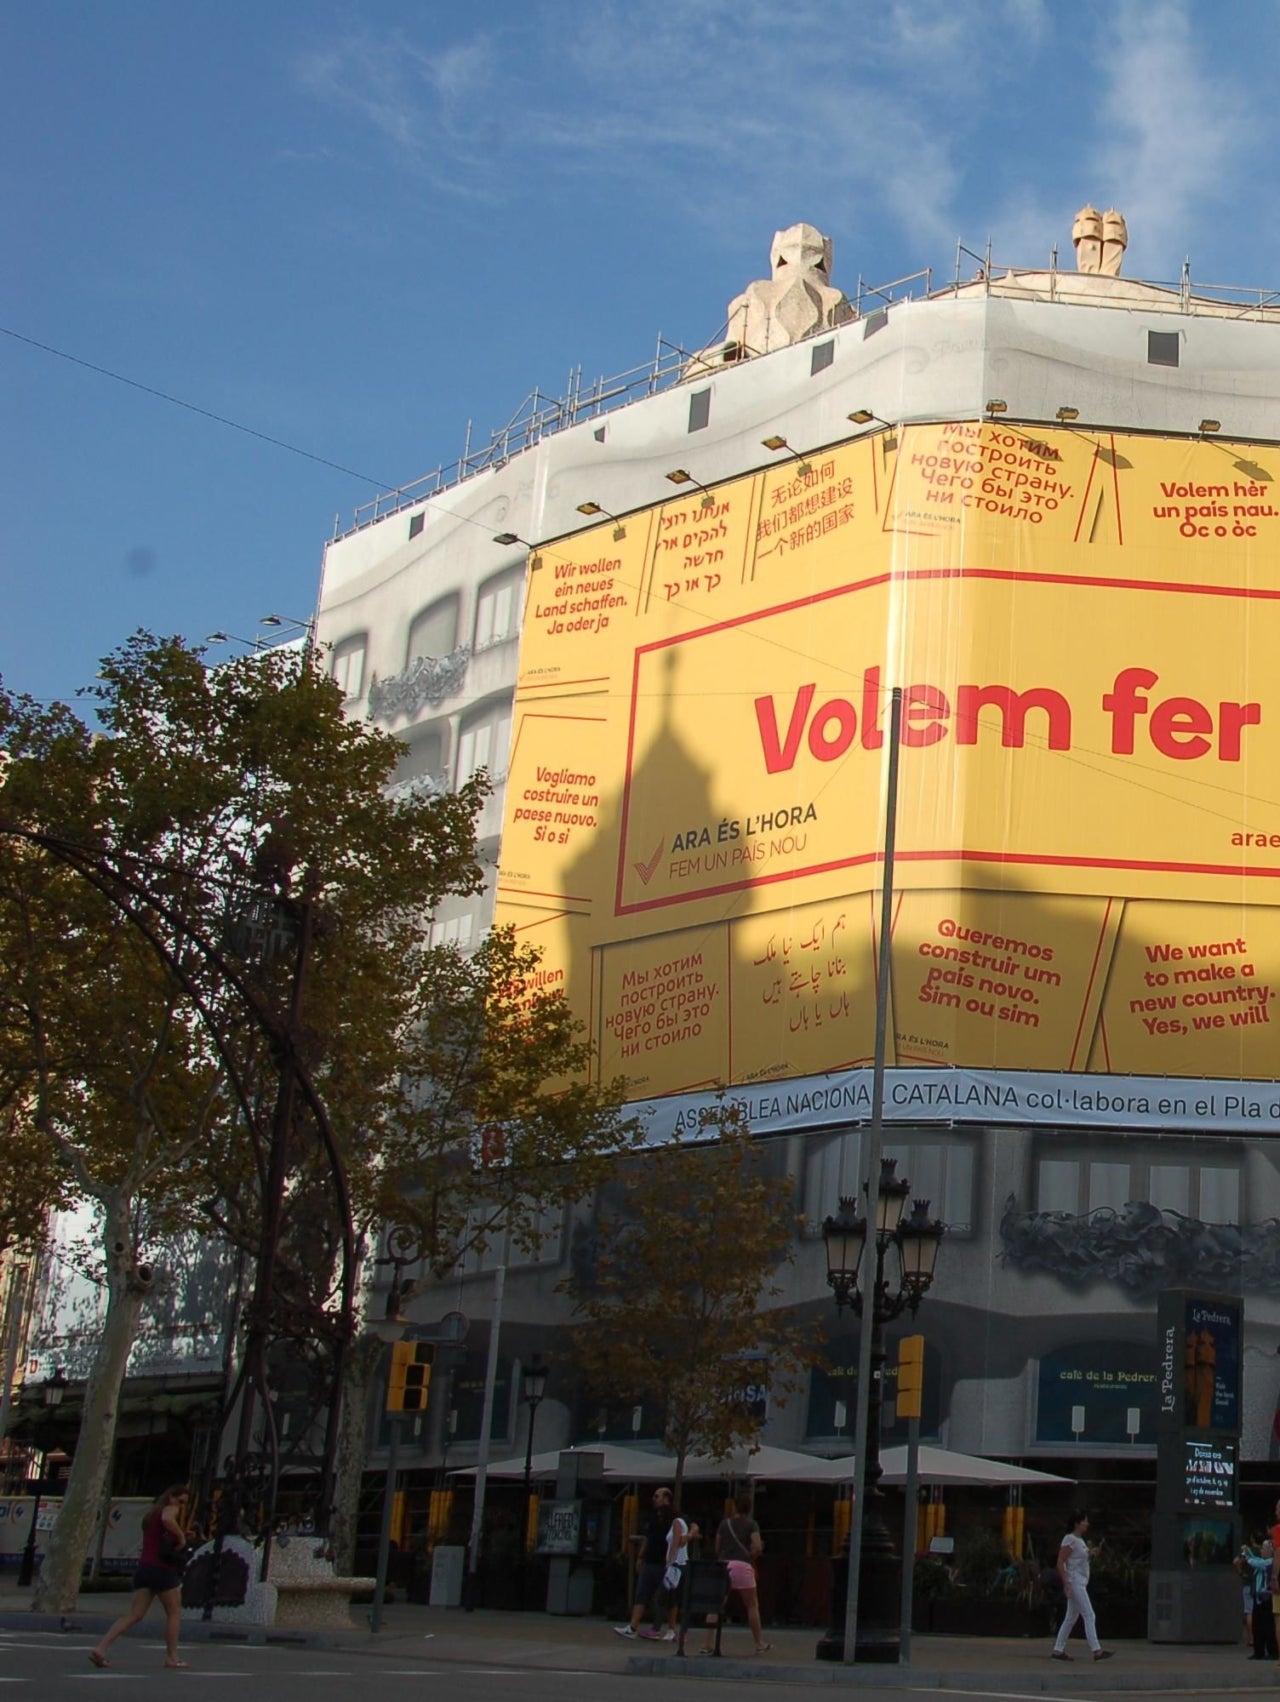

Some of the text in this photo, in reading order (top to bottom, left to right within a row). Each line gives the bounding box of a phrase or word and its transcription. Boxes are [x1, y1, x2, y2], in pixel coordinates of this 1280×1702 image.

[989, 431, 1059, 460] хотим
[911, 454, 1075, 500] новую страну.
[921, 468, 1058, 510] Чего бы это
[1160, 480, 1268, 498] Volem hèr
[926, 490, 954, 504] ни
[962, 495, 1043, 524] стоило
[1153, 500, 1279, 522] un país nau.
[758, 503, 854, 559] 一个新的国家
[1214, 526, 1227, 537] o
[1232, 520, 1257, 537] òc
[555, 558, 621, 579] Wir wollen
[684, 549, 724, 570] חדשה
[555, 578, 614, 598] ein neues
[664, 573, 721, 602] כך או כך
[535, 594, 627, 618] Land schaffen.
[547, 613, 609, 635] Ja oder ja
[755, 665, 1071, 775] Volem
[1103, 667, 1261, 761] fer
[537, 766, 596, 788] Vogliamo
[523, 788, 599, 807] costruire un
[513, 808, 597, 827] paese nuovo.
[547, 831, 556, 842] o
[671, 827, 711, 853] ARA
[717, 818, 740, 844] ÉS
[669, 833, 808, 880] FEM UN PAÍS NOU
[938, 919, 1054, 961] Queremos
[1145, 938, 1247, 963] We want
[623, 953, 703, 990] Мы хотим
[919, 942, 1062, 986] construir um
[1144, 963, 1255, 987] to make a
[621, 971, 704, 1007] построить
[926, 967, 1039, 1005] país novo.
[1130, 985, 1276, 1013] new country.
[606, 983, 719, 1029] новую страну.
[918, 984, 1039, 1028] Sim ou sim
[1142, 1005, 1270, 1035] Yes, we will
[614, 1003, 710, 1040] Чего бы это
[621, 1023, 701, 1058] ни стоило
[786, 1083, 885, 1115] NACIONA
[892, 1083, 1019, 1107] CATALANA
[1026, 1088, 1150, 1114] col·labora
[1158, 1097, 1187, 1116] en
[1195, 1095, 1215, 1117] el
[1225, 1096, 1261, 1118] Pla
[1162, 1326, 1175, 1394] Pedrera
[1086, 1371, 1100, 1381] de
[1103, 1370, 1113, 1381] la
[1118, 1371, 1157, 1383] Pedrer
